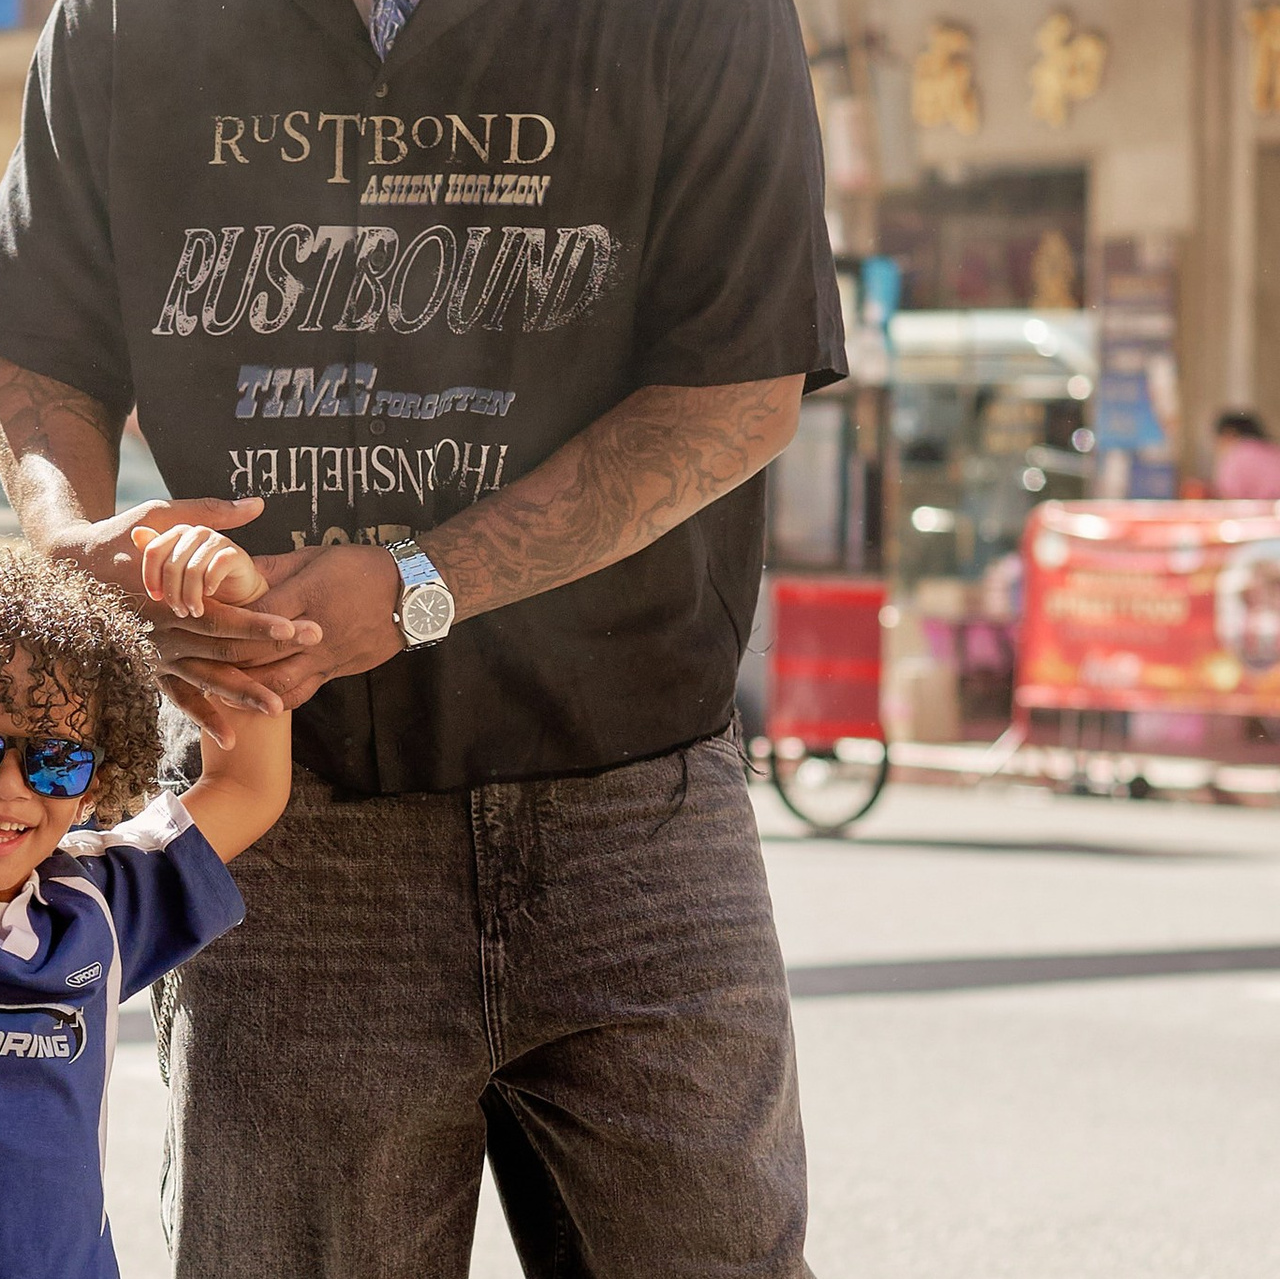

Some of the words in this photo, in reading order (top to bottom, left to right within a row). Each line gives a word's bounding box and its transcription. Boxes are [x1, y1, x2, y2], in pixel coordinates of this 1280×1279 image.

[208, 110, 557, 184] RUSTBOND
[360, 174, 444, 206] ASHEN
[444, 174, 551, 206] HORIZON
[152, 224, 620, 336] RUSTBOUND
[234, 363, 379, 419] TIME
[372, 386, 517, 420] FORGOTTEN
